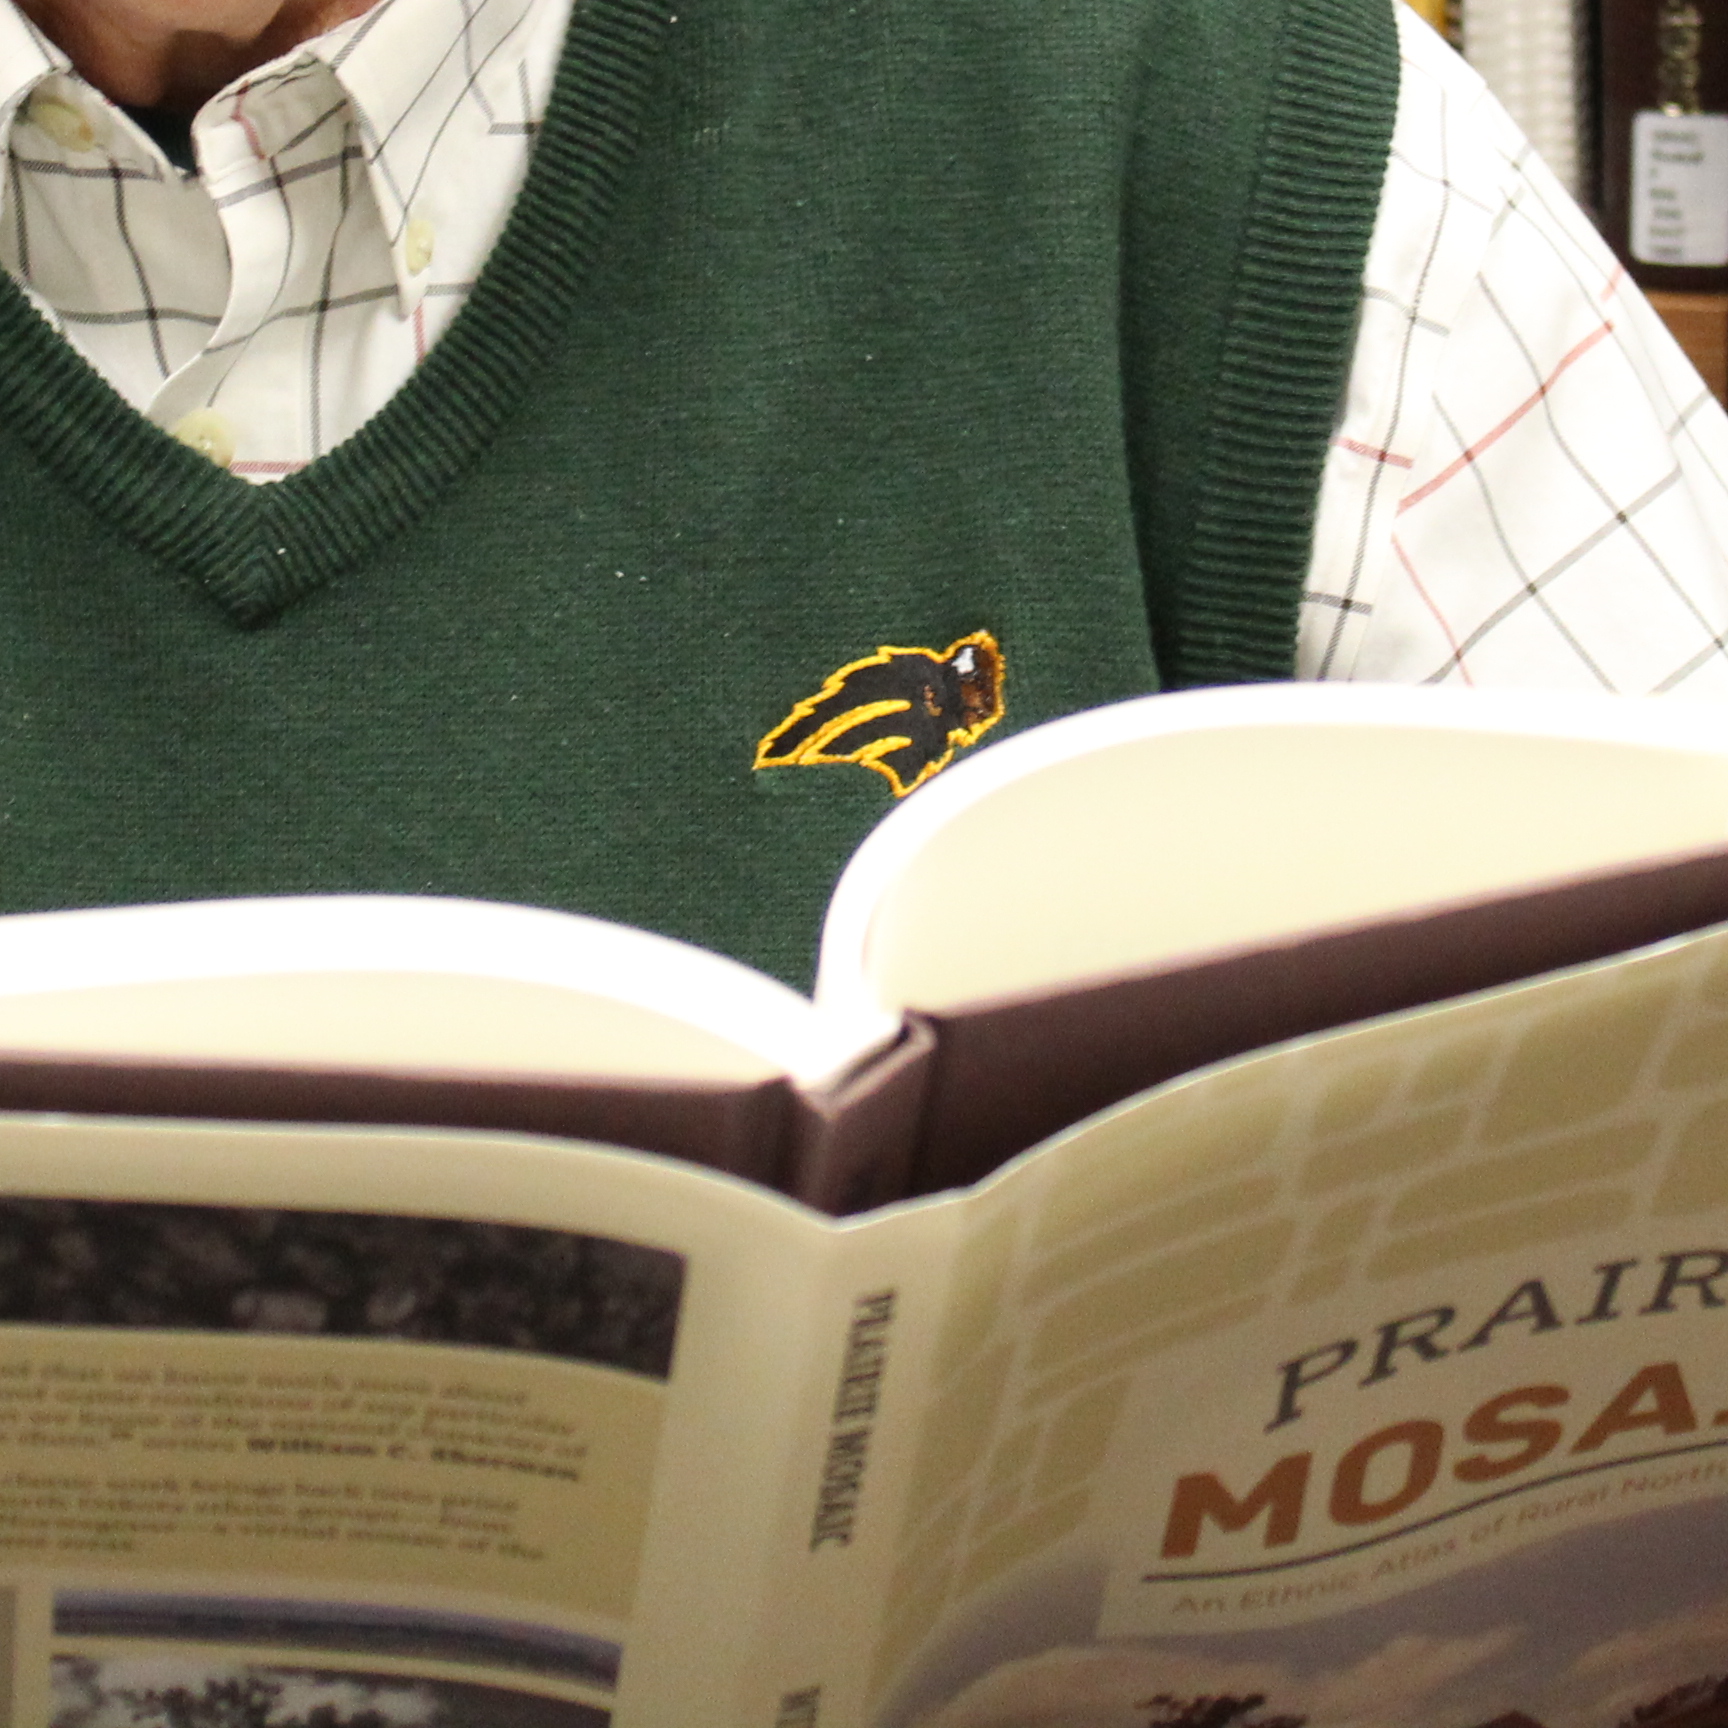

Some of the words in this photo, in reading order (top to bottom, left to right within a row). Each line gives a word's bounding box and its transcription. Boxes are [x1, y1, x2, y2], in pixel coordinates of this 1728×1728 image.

[1173, 1594, 1229, 1615] An
[1239, 1572, 1359, 1611] Ethnic
[1375, 1538, 1457, 1578] Atlas
[1470, 1512, 1508, 1550] of
[1516, 1485, 1607, 1525] Rural
[1620, 1464, 1726, 1498] North
